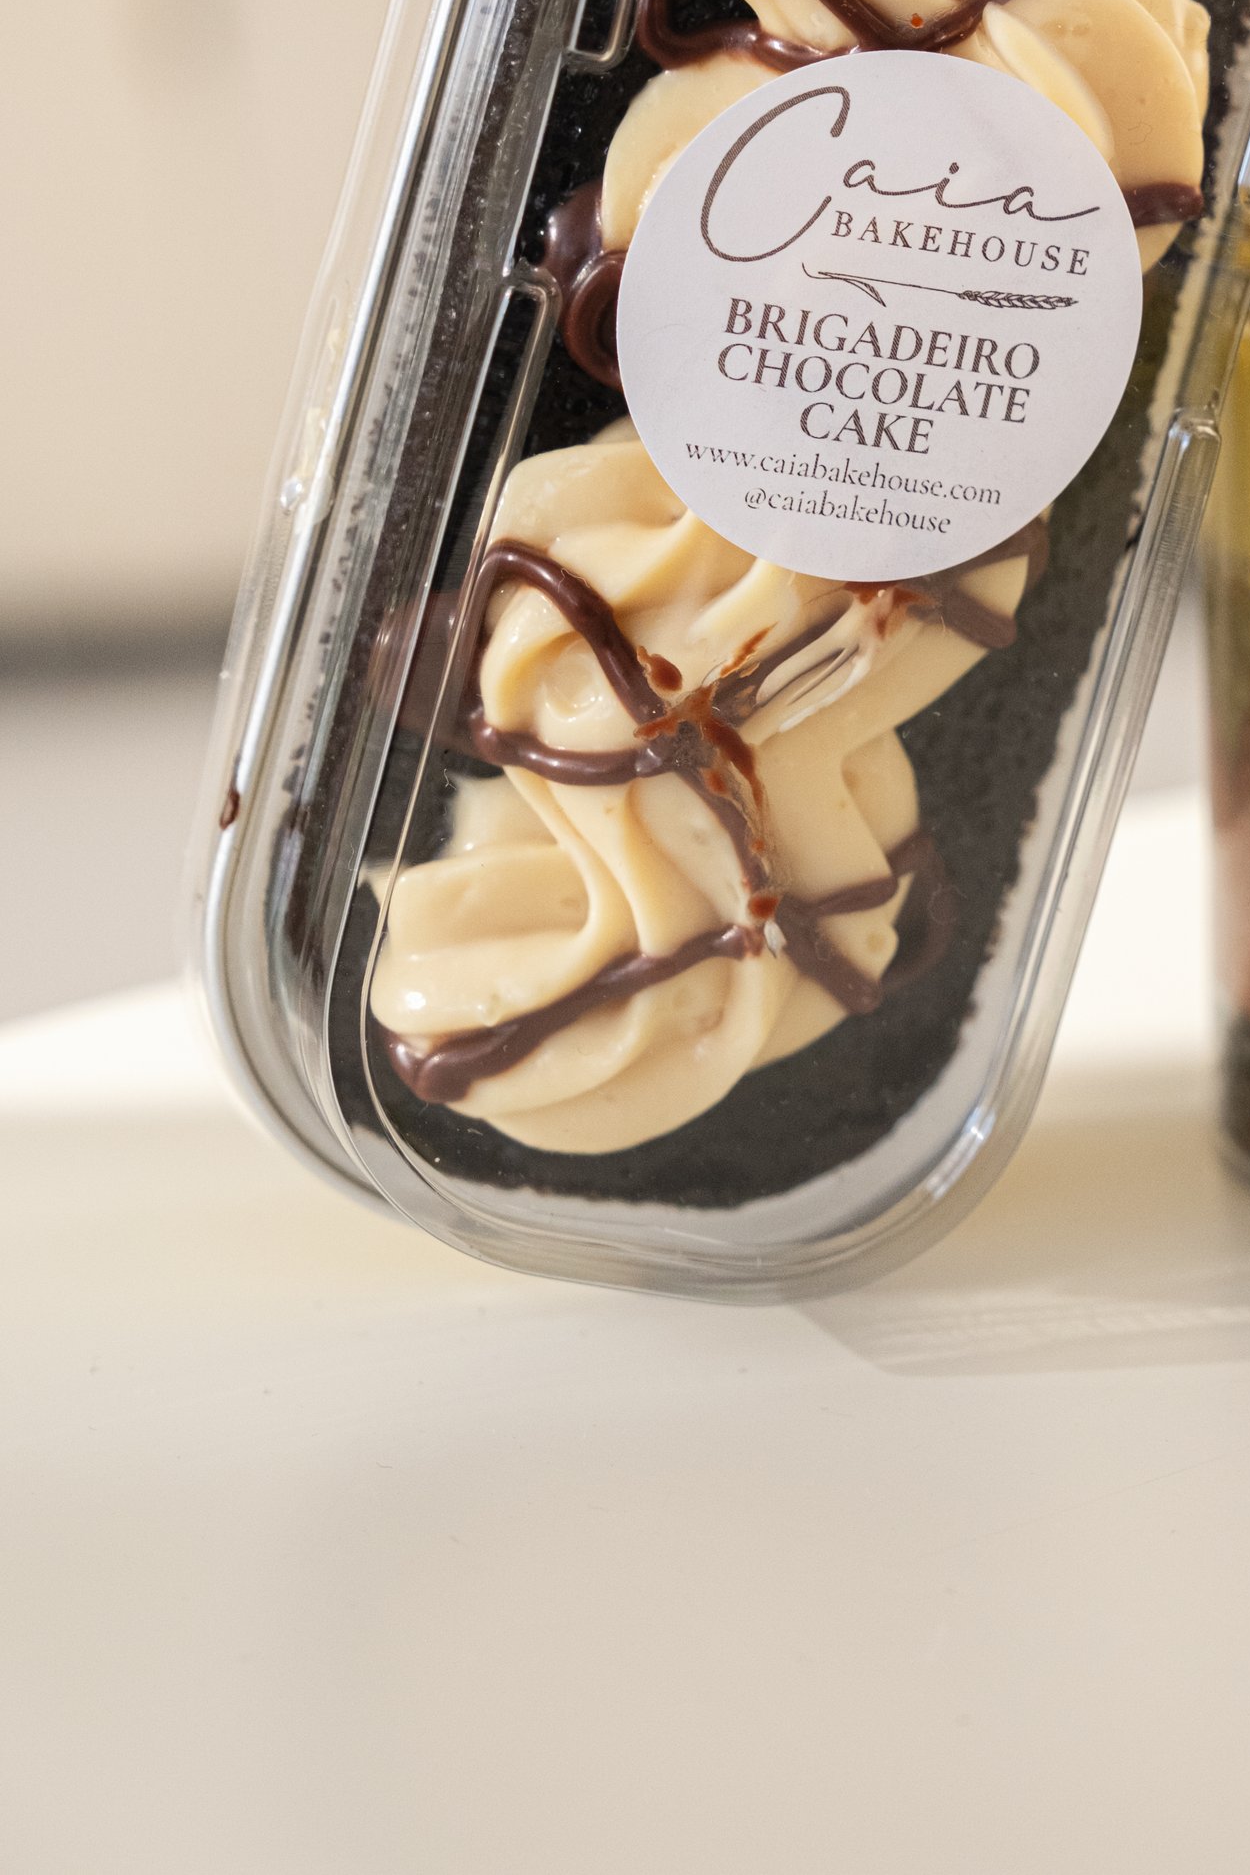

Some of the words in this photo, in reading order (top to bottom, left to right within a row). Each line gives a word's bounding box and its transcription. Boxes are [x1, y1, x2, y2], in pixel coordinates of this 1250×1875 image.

[700, 85, 1100, 262] Caia
[831, 210, 1091, 276] BAKEHOUSE
[723, 297, 1041, 380] BRIGADEIRO
[717, 343, 1032, 424] CHOCOLATE
[799, 401, 935, 455] CAKE
[685, 440, 1002, 506] www.caiabakehouse.com
[744, 487, 952, 535] @caiabakehouse
